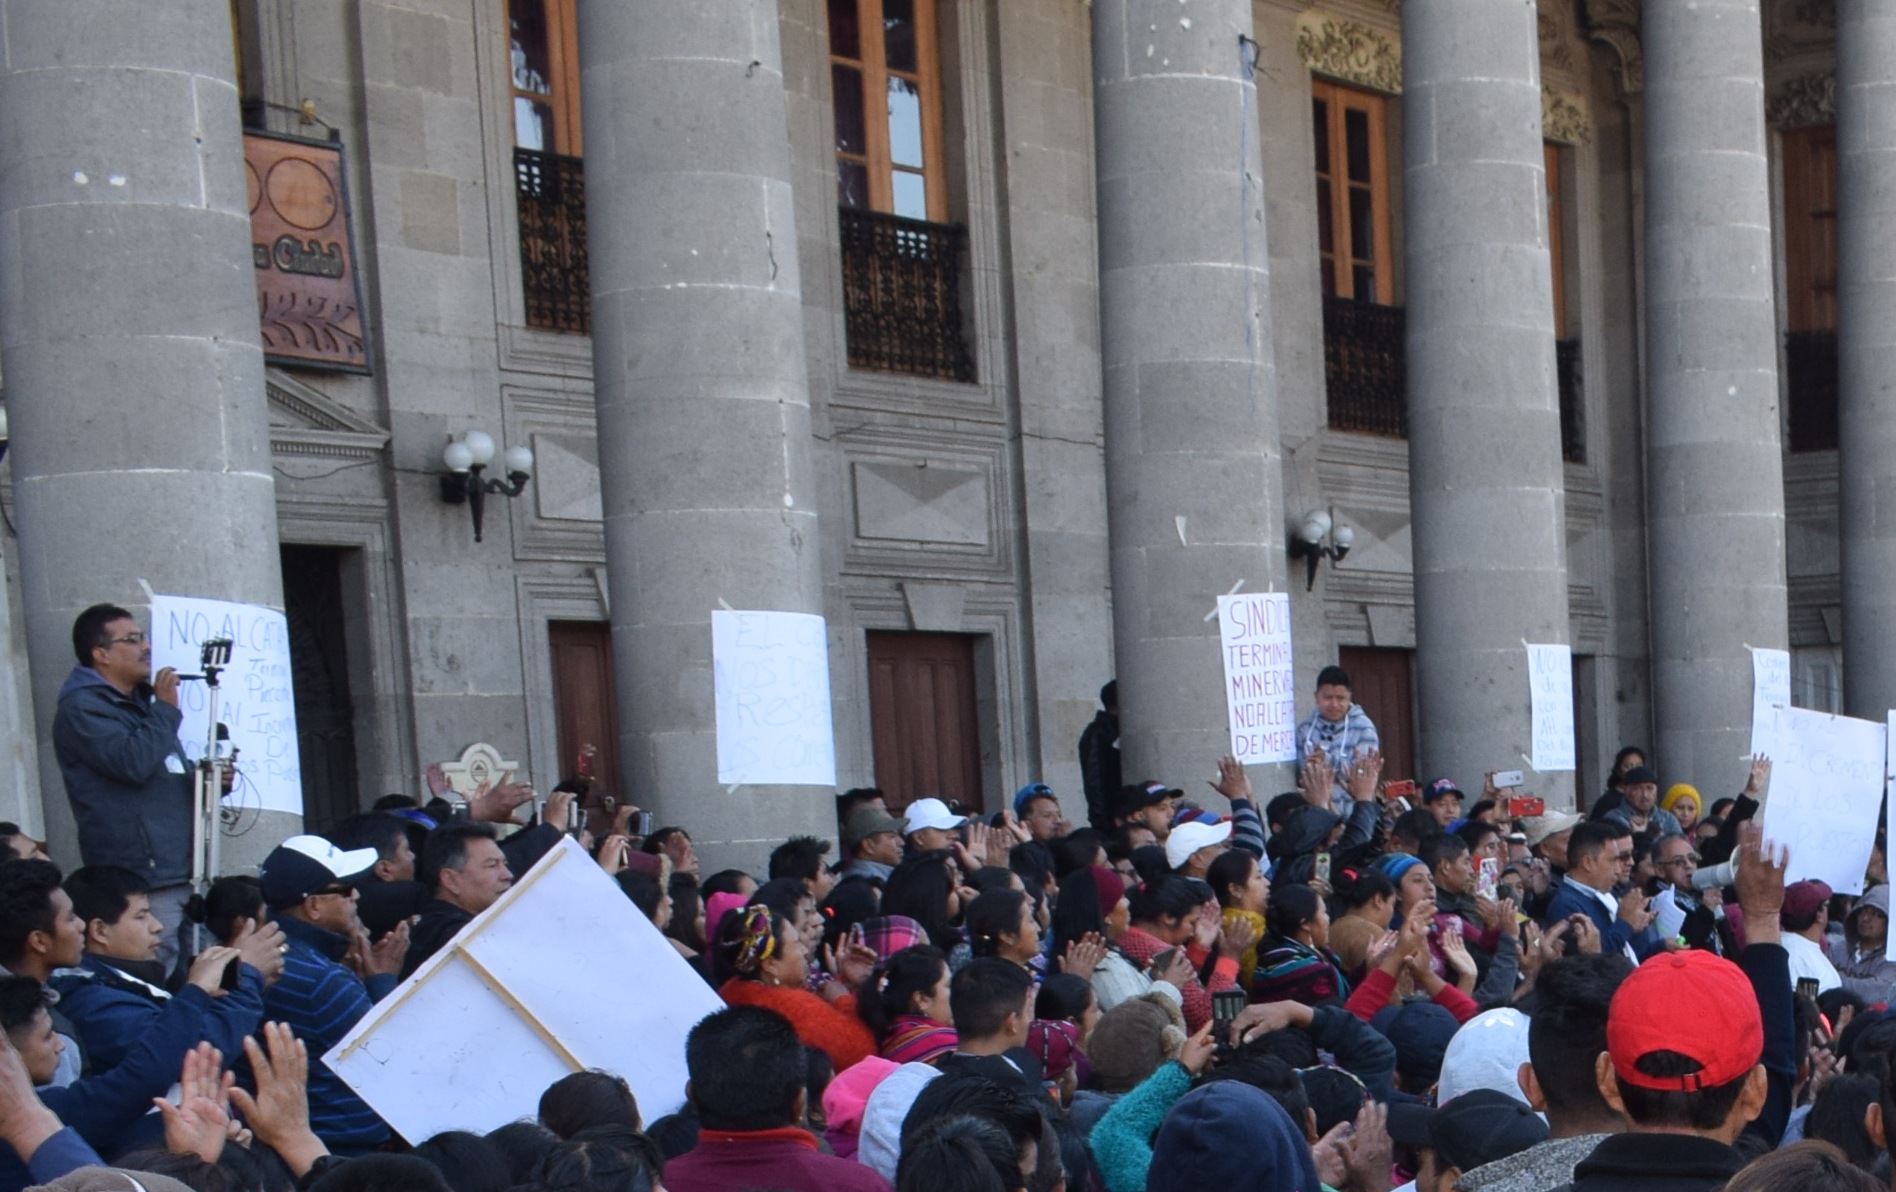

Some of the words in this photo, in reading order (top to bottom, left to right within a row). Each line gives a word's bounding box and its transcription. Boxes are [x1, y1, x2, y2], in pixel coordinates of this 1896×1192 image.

[169, 609, 211, 650] NO
[223, 612, 247, 649] AL
[1235, 733, 1259, 756] DE
